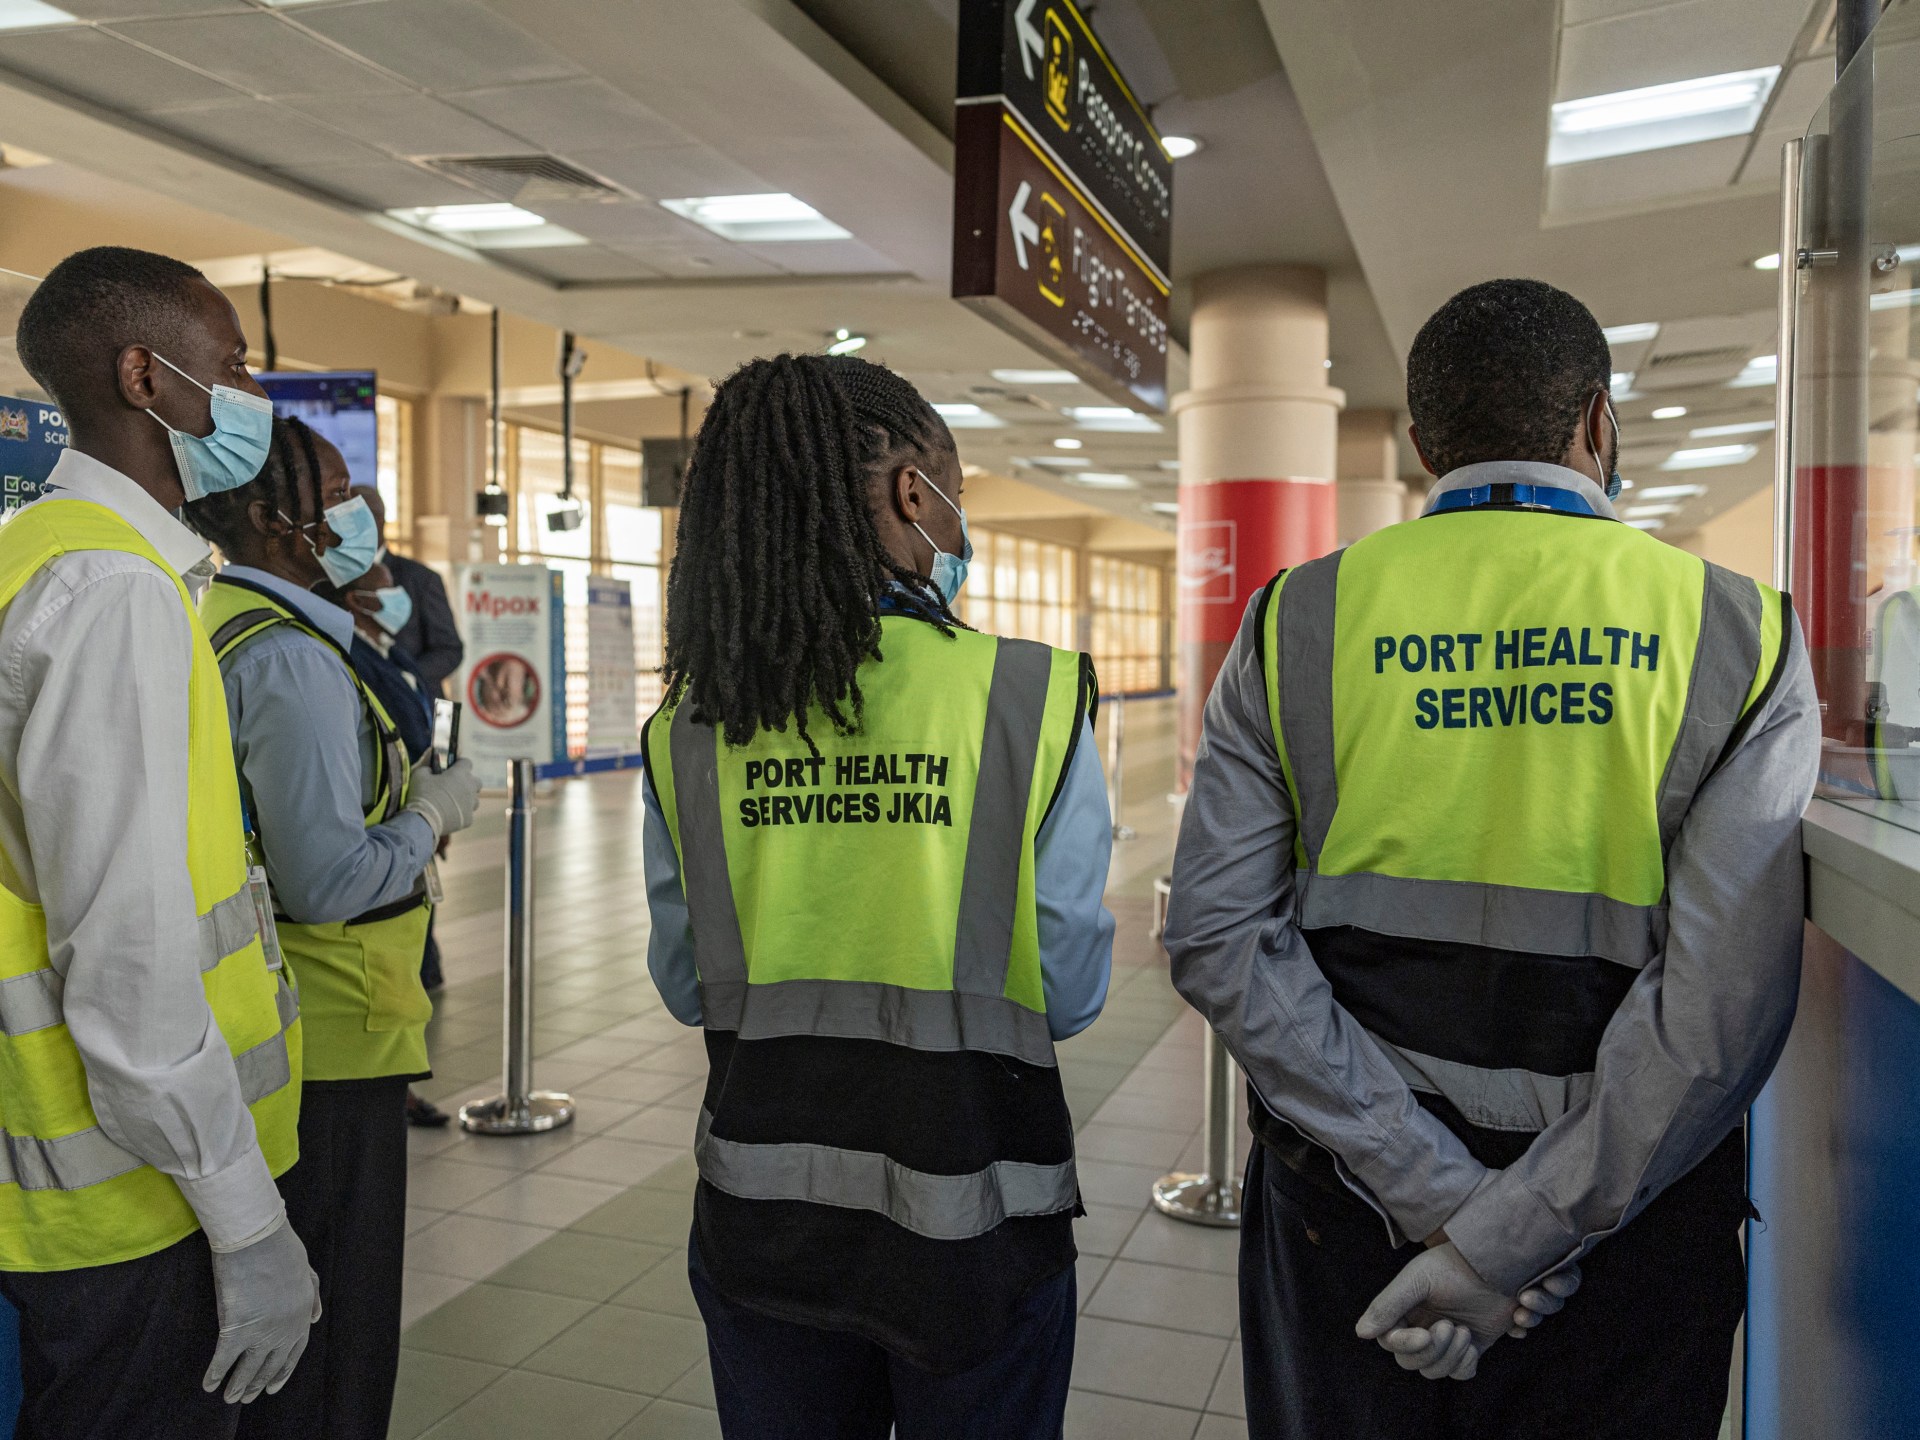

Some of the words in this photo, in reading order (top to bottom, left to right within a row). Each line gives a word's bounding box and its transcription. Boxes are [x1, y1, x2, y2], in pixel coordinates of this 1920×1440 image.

[39, 409, 67, 428] PO
[21, 481, 36, 493] QR
[466, 591, 540, 619] Mpox
[1374, 633, 1482, 674] PORT
[1495, 627, 1660, 672] HEALTH
[1414, 682, 1614, 730] SERVICES
[745, 756, 826, 790] PORT
[835, 753, 949, 787] HEALTH
[739, 792, 881, 828] SERVICES
[886, 792, 952, 827] JKIA
